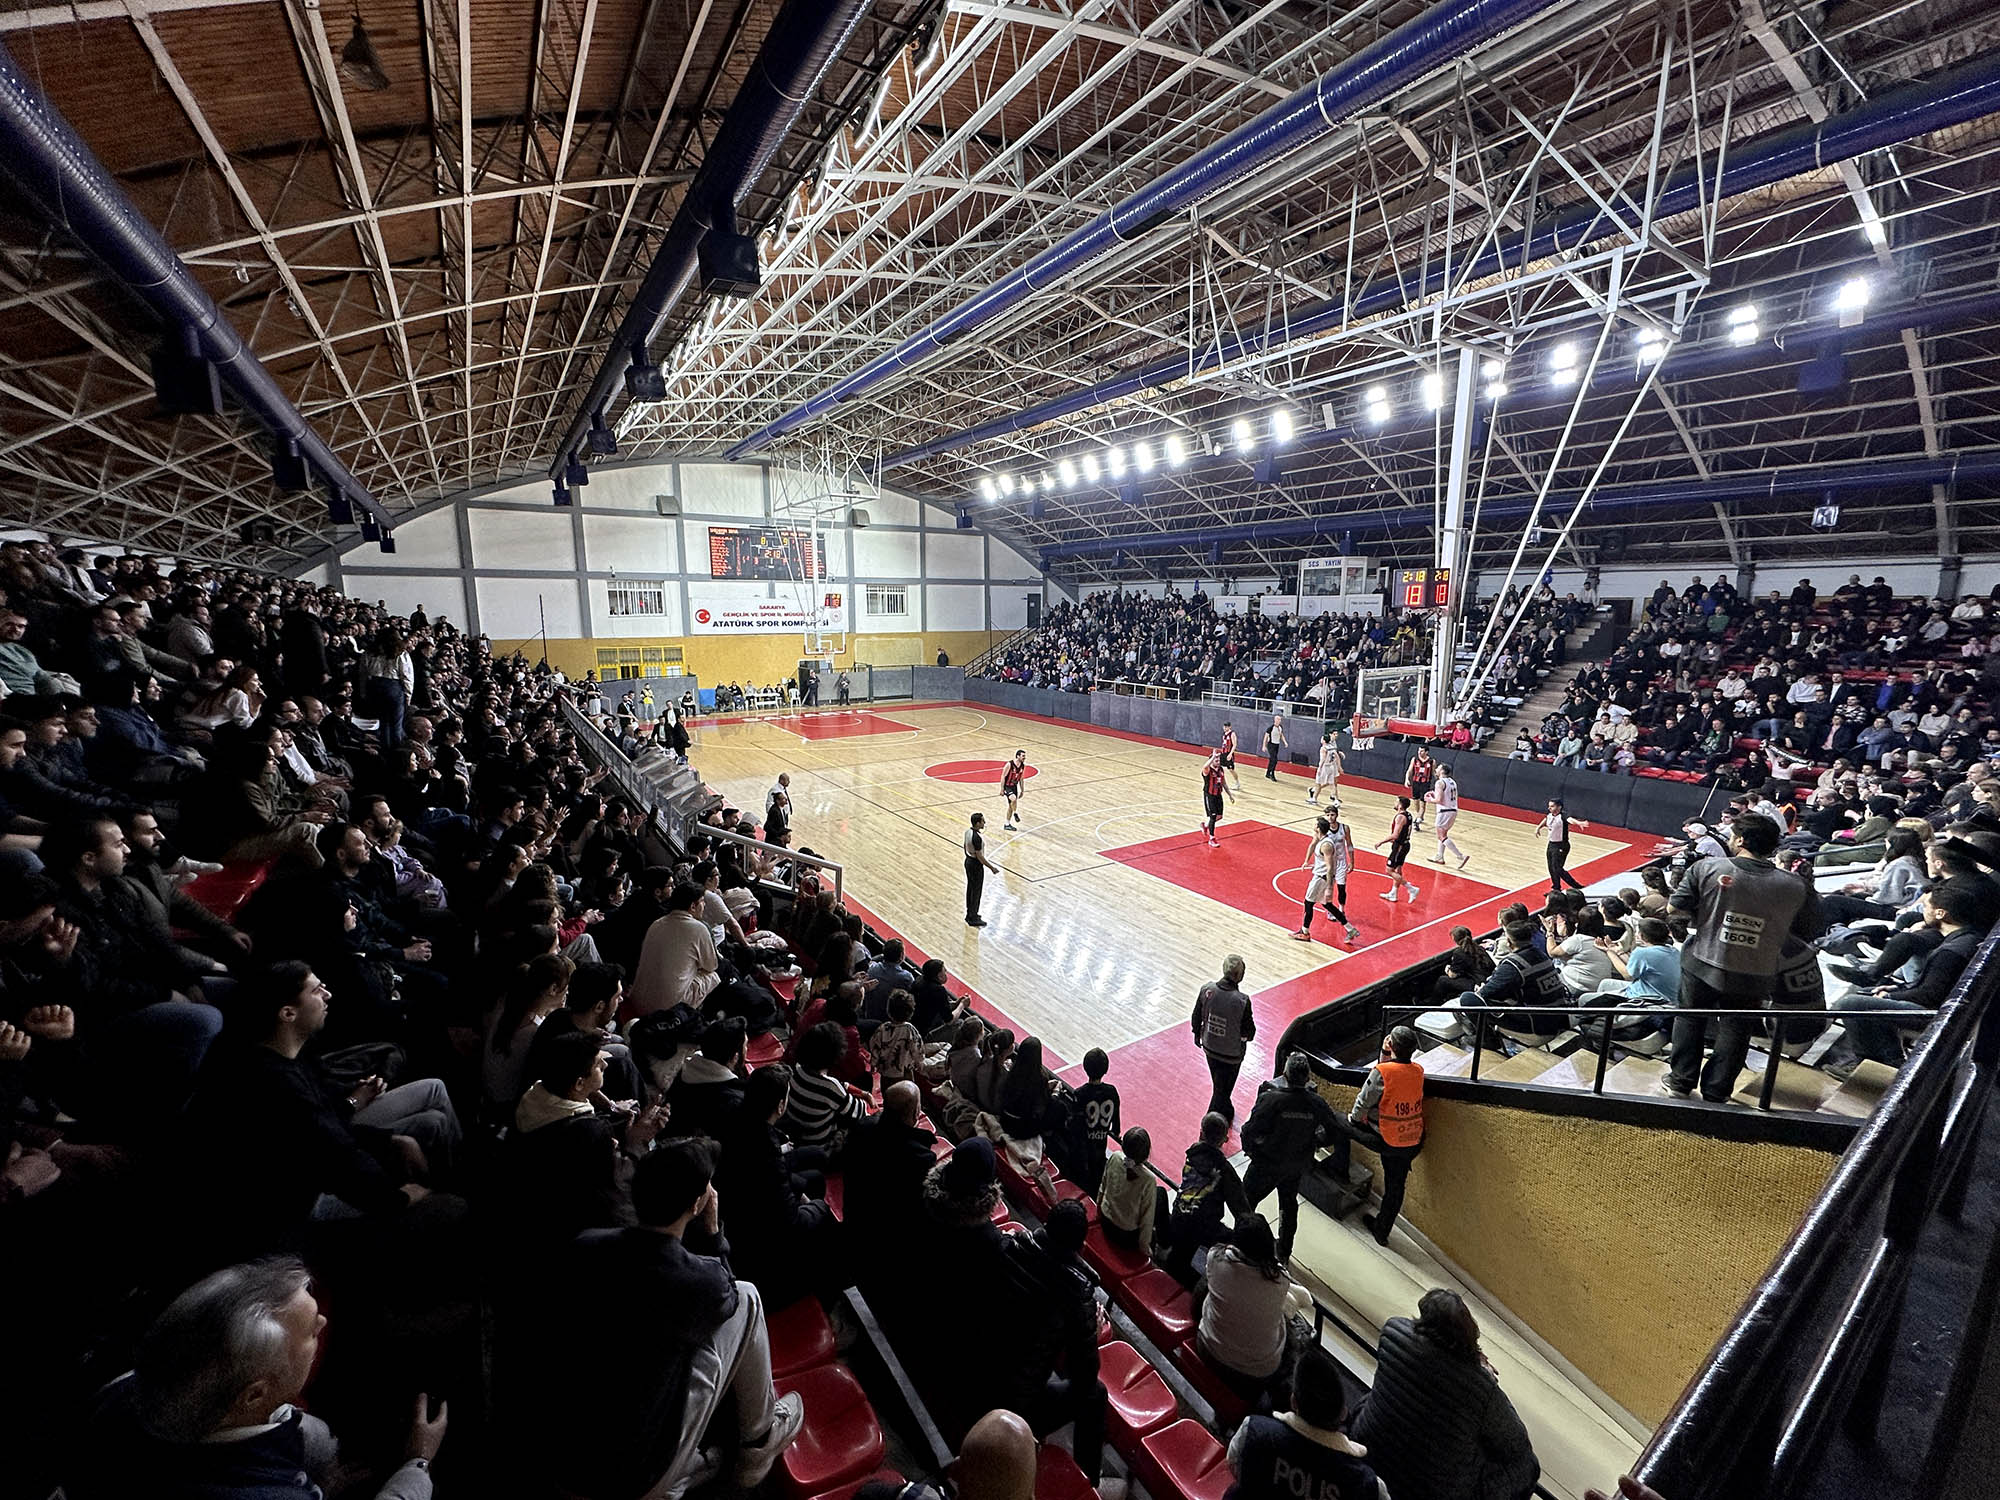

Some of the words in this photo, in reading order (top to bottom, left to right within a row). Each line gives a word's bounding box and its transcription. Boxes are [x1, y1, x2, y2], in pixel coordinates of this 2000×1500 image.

[1402, 570, 1426, 583] 2:18
[1404, 584, 1422, 606] 18
[1435, 584, 1447, 604] 18
[712, 619, 754, 628] ATATÜRK
[756, 620, 780, 628] SPOR
[1087, 1099, 1114, 1128] 99
